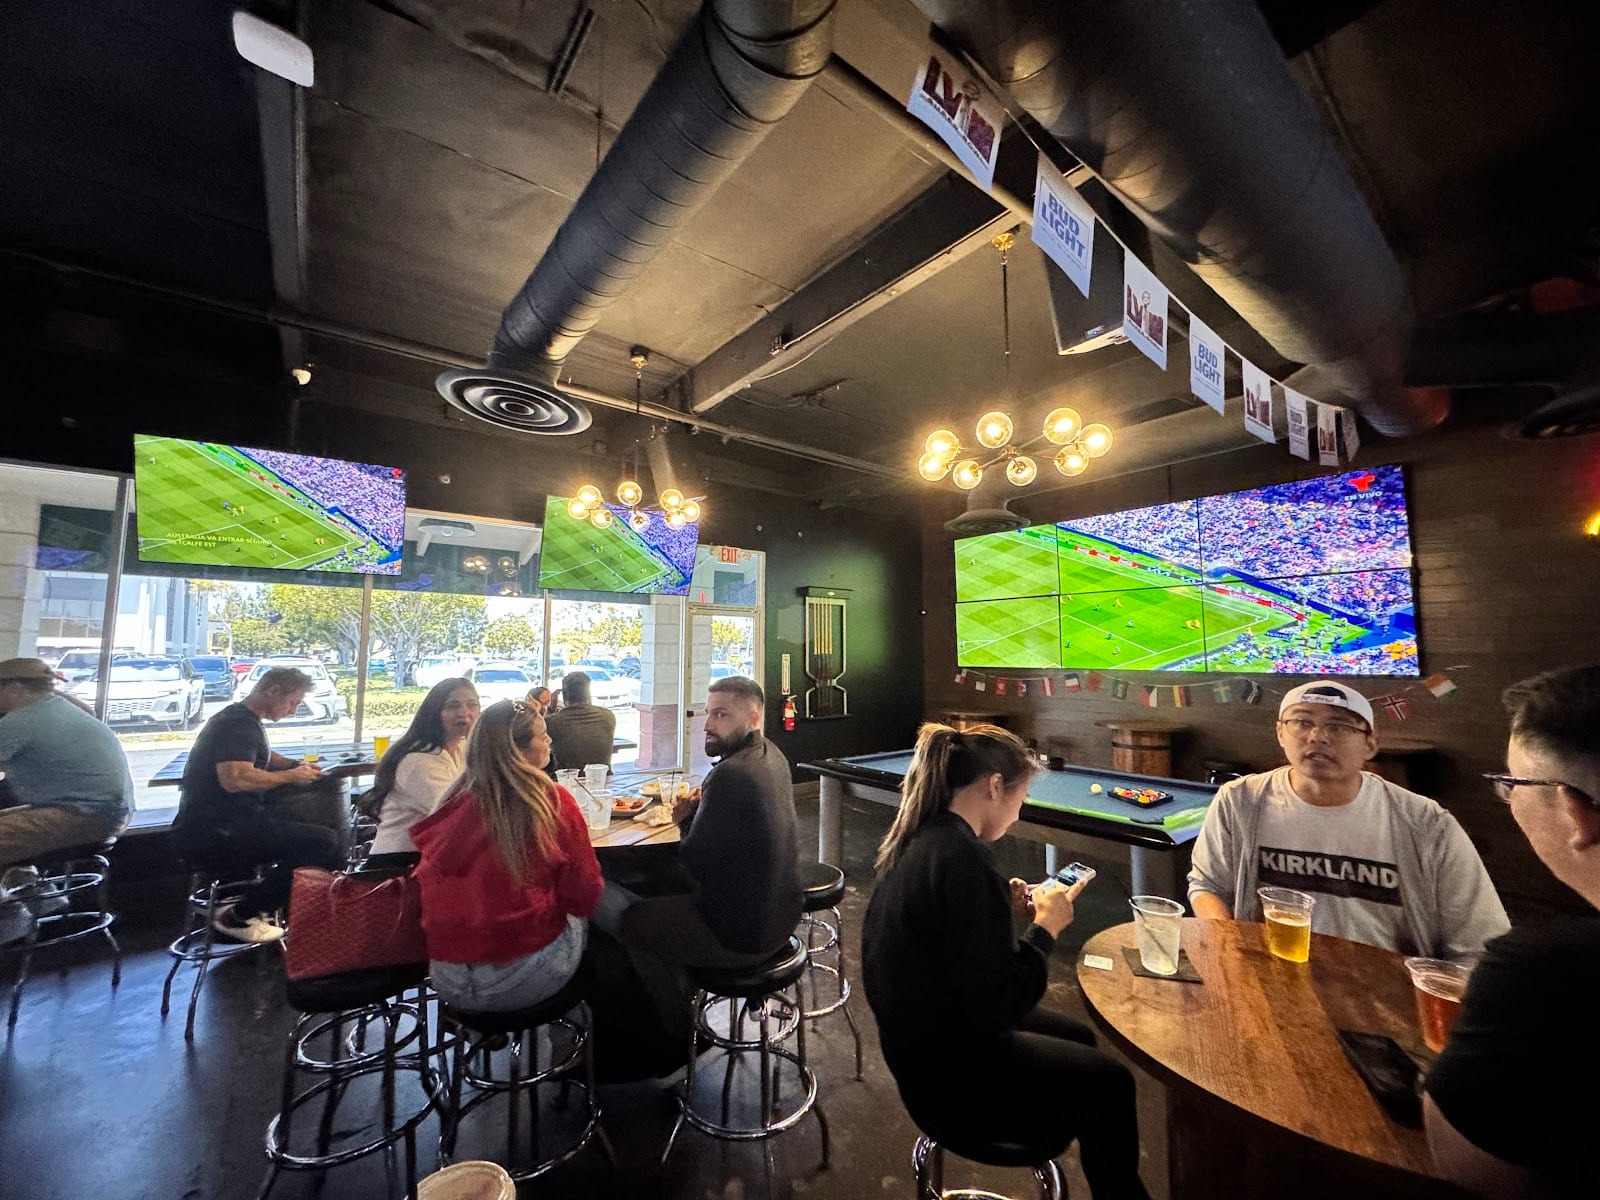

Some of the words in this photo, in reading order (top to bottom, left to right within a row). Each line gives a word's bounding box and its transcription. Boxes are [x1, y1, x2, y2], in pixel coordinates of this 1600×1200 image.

[1048, 191, 1080, 237] BUD
[1041, 202, 1086, 259] LIGHT
[1198, 343, 1218, 369] BUD
[1194, 355, 1221, 386] LIGHT
[1358, 491, 1383, 499] VIVO
[166, 532, 206, 541] AUSTRALIA
[721, 547, 738, 563] EXIT
[1261, 850, 1400, 889] KIRKLAND
